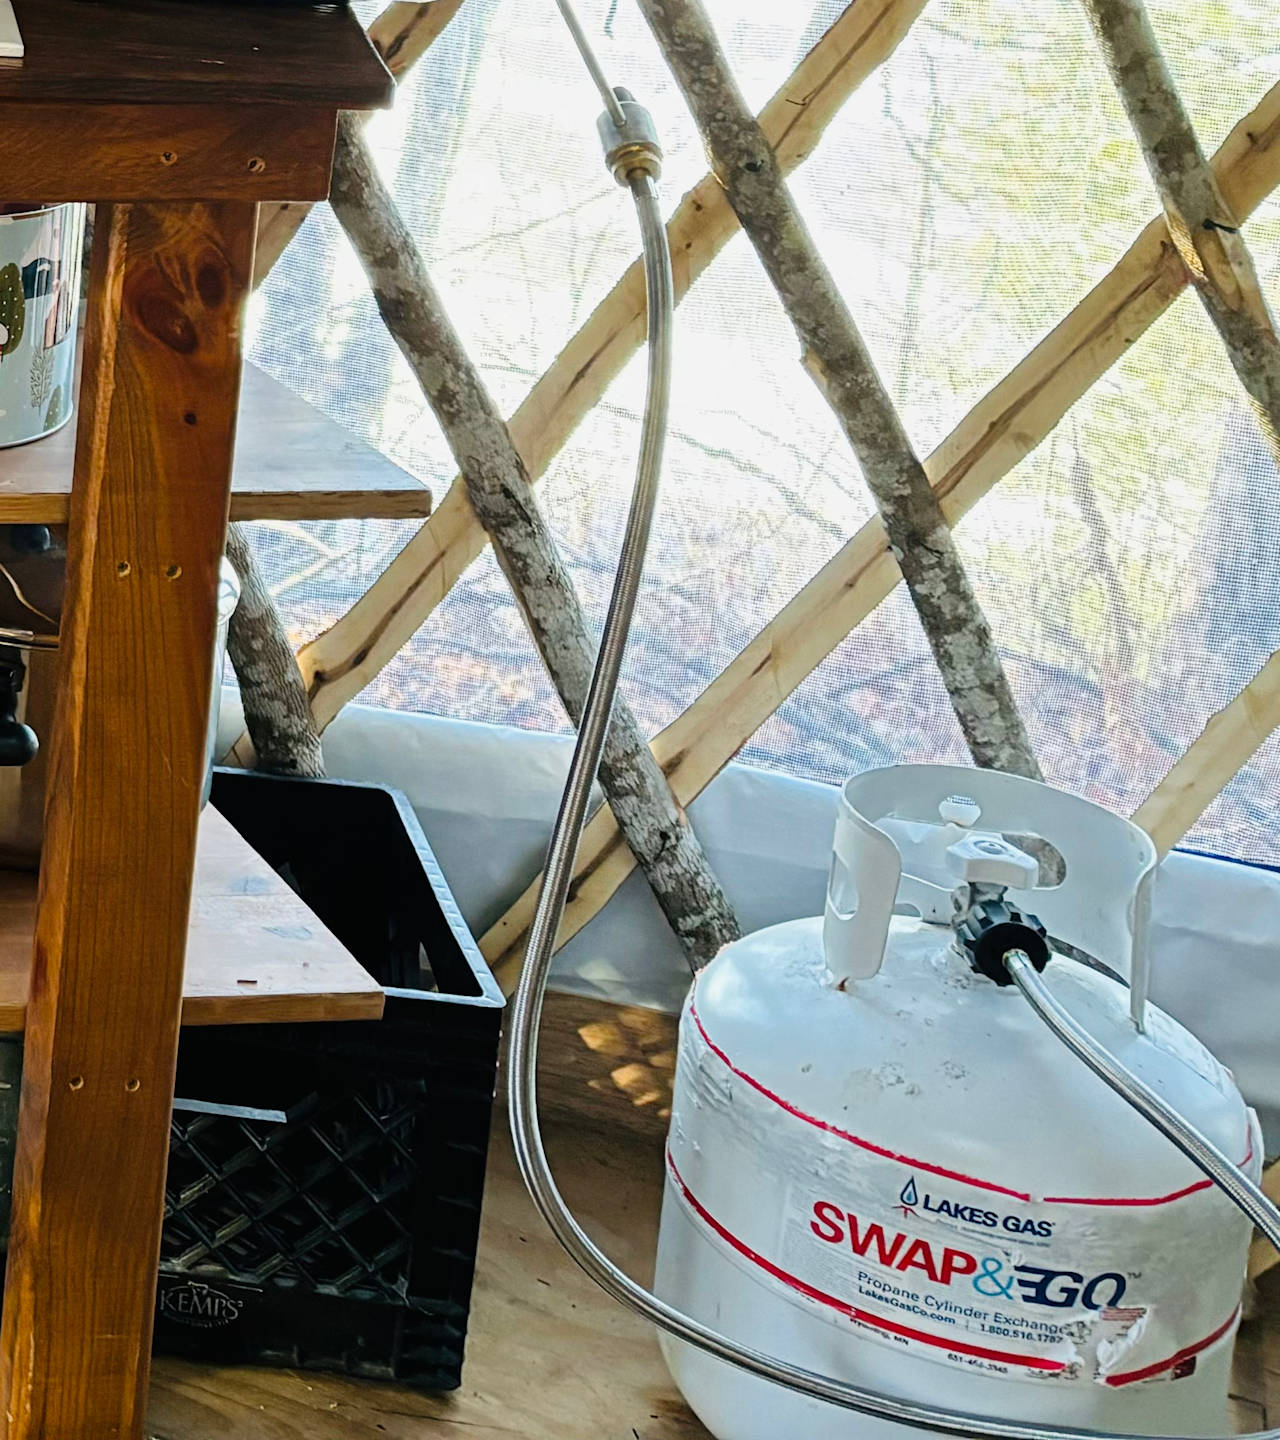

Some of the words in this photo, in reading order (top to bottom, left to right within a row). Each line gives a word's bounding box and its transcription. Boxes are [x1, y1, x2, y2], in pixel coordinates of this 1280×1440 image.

[923, 1194, 998, 1227] LAKES
[1002, 1215, 1054, 1238] GAS
[160, 1289, 239, 1320] KEMPS
[857, 1271, 919, 1302] Propane
[925, 1295, 990, 1322] Cylinder
[858, 1285, 956, 1325] LakesGasCo.com
